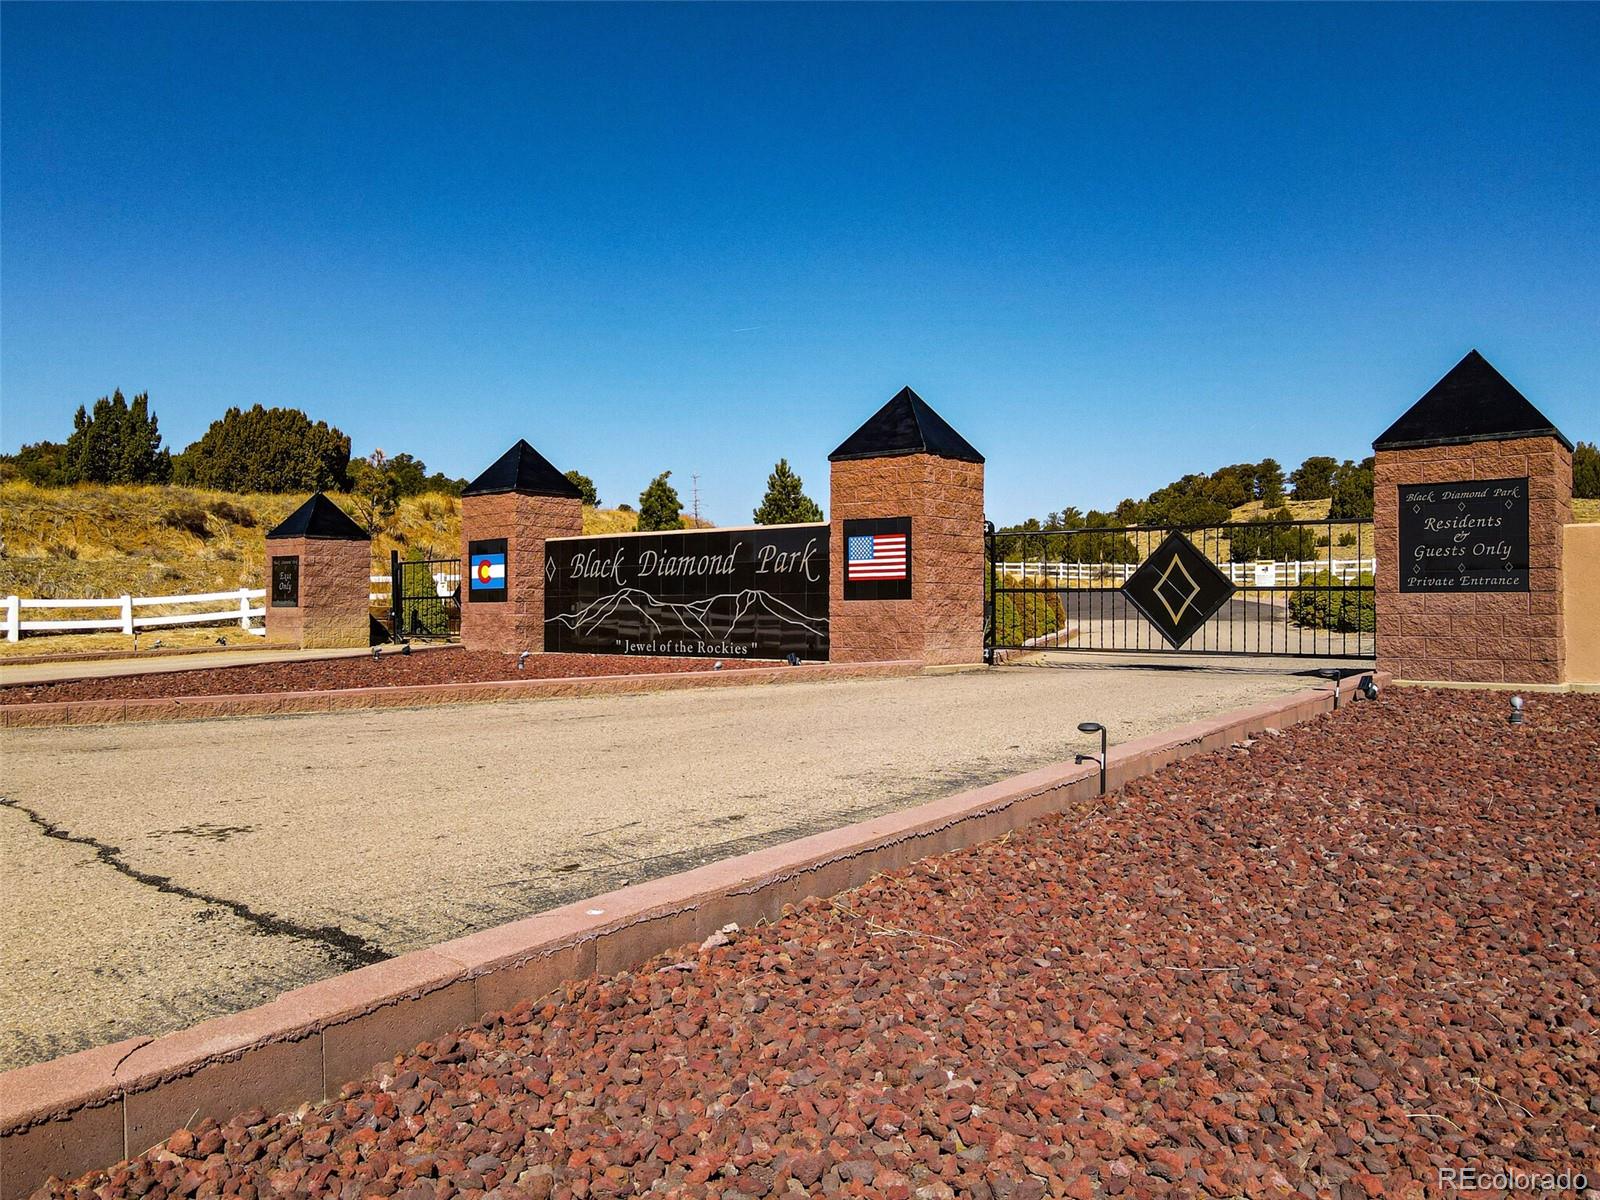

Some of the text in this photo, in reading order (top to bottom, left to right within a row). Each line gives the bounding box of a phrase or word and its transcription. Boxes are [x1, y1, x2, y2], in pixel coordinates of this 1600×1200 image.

[1405, 486, 1521, 503] Black Diamond Park
[1424, 514, 1502, 532] Residents
[1453, 530, 1471, 543] &
[1414, 540, 1512, 561] Guests Only
[570, 537, 820, 586] Black Diamond Park
[1407, 575, 1520, 587] Private Entrance
[660, 640, 672, 652] of
[675, 640, 693, 653] the
